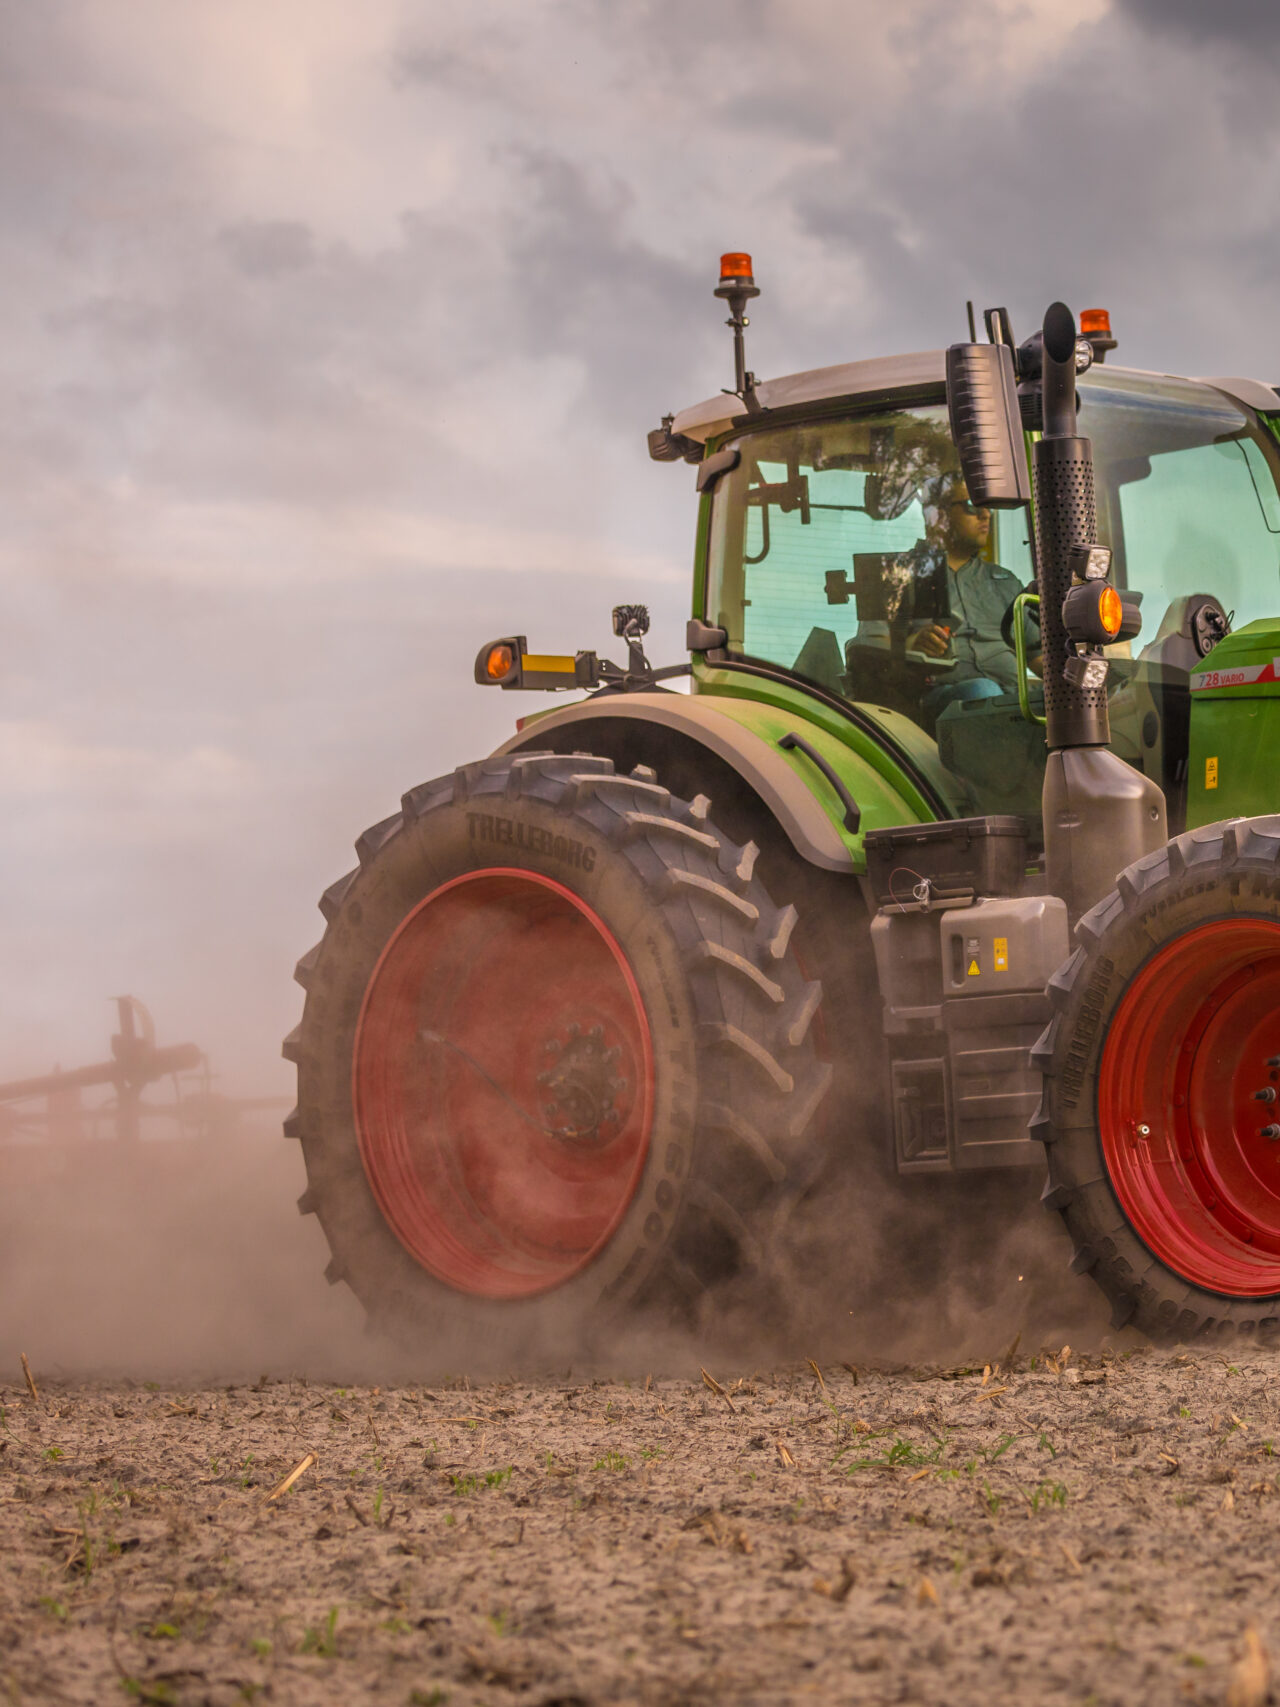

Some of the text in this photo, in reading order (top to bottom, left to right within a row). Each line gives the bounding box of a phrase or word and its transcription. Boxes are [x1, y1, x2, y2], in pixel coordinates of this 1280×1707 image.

[1199, 672, 1245, 687] 728 VARIO
[465, 812, 597, 873] TRELLEBORG
[1059, 955, 1115, 1109] TRELLEBORG
